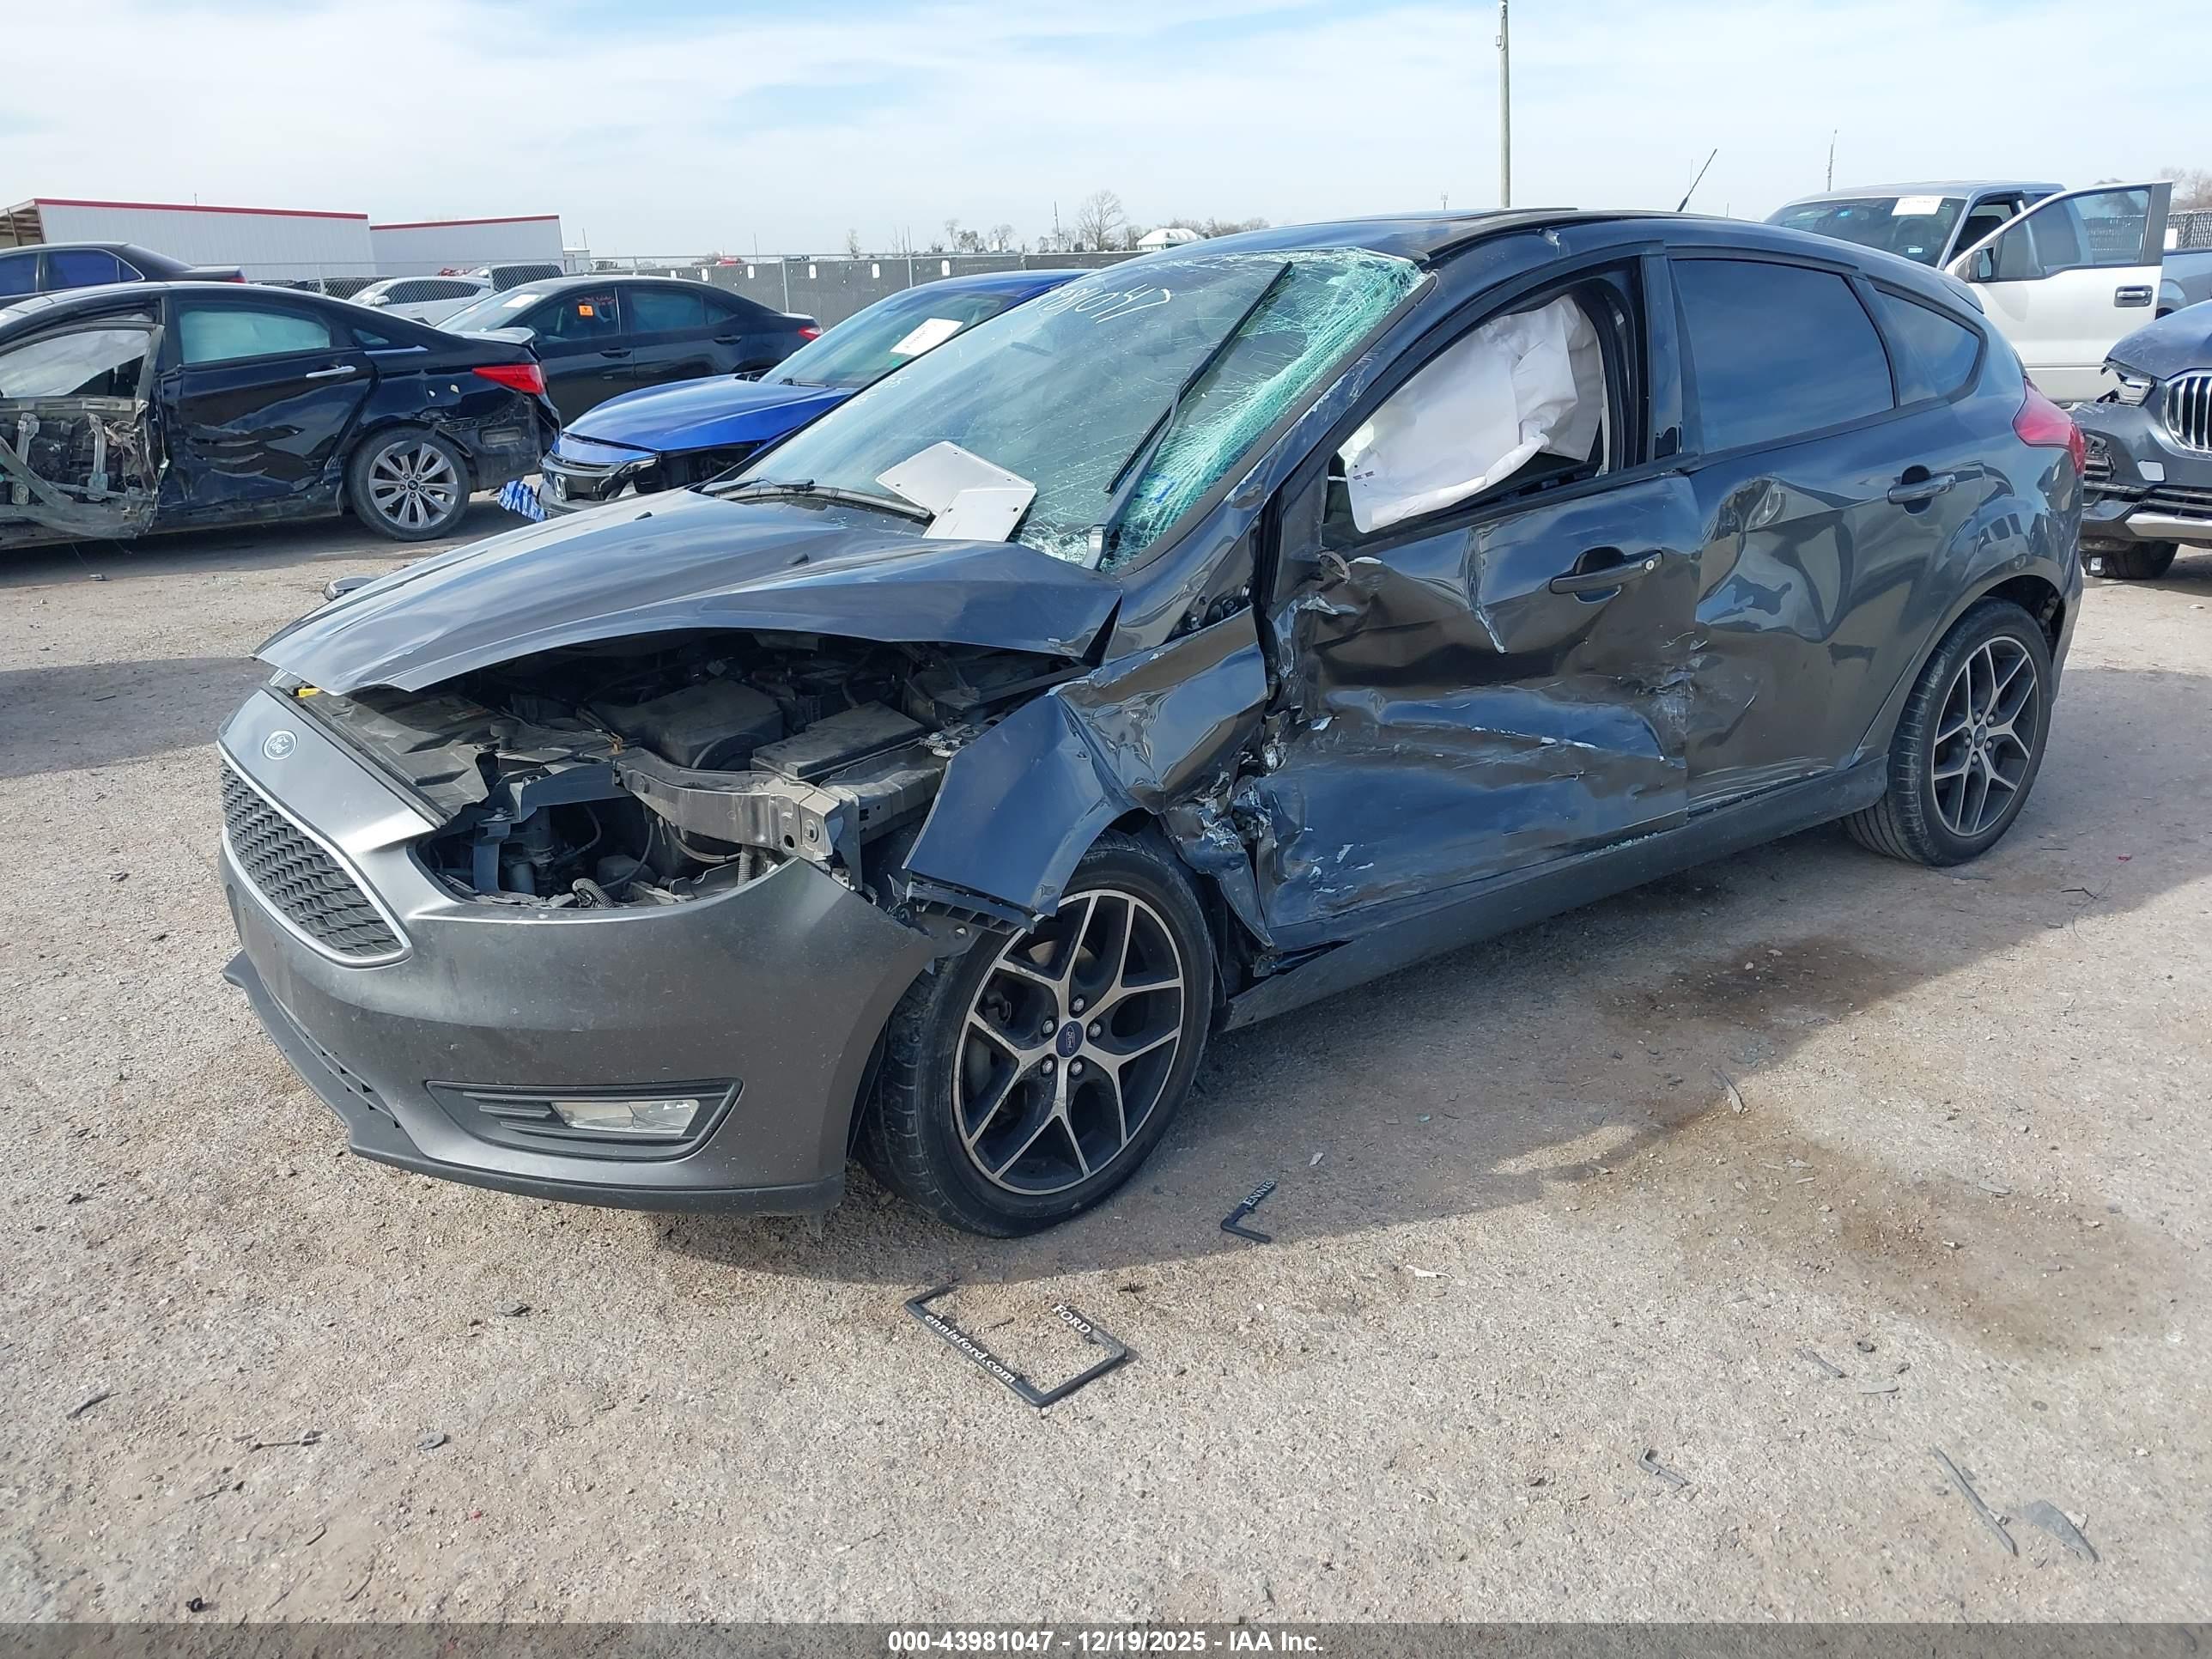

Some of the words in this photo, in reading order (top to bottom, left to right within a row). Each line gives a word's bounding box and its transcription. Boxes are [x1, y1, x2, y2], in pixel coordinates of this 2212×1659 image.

[1242, 1180, 1275, 1207] ENNIS
[1051, 1304, 1092, 1334] FORD
[925, 1314, 1016, 1383] ennisford.com
